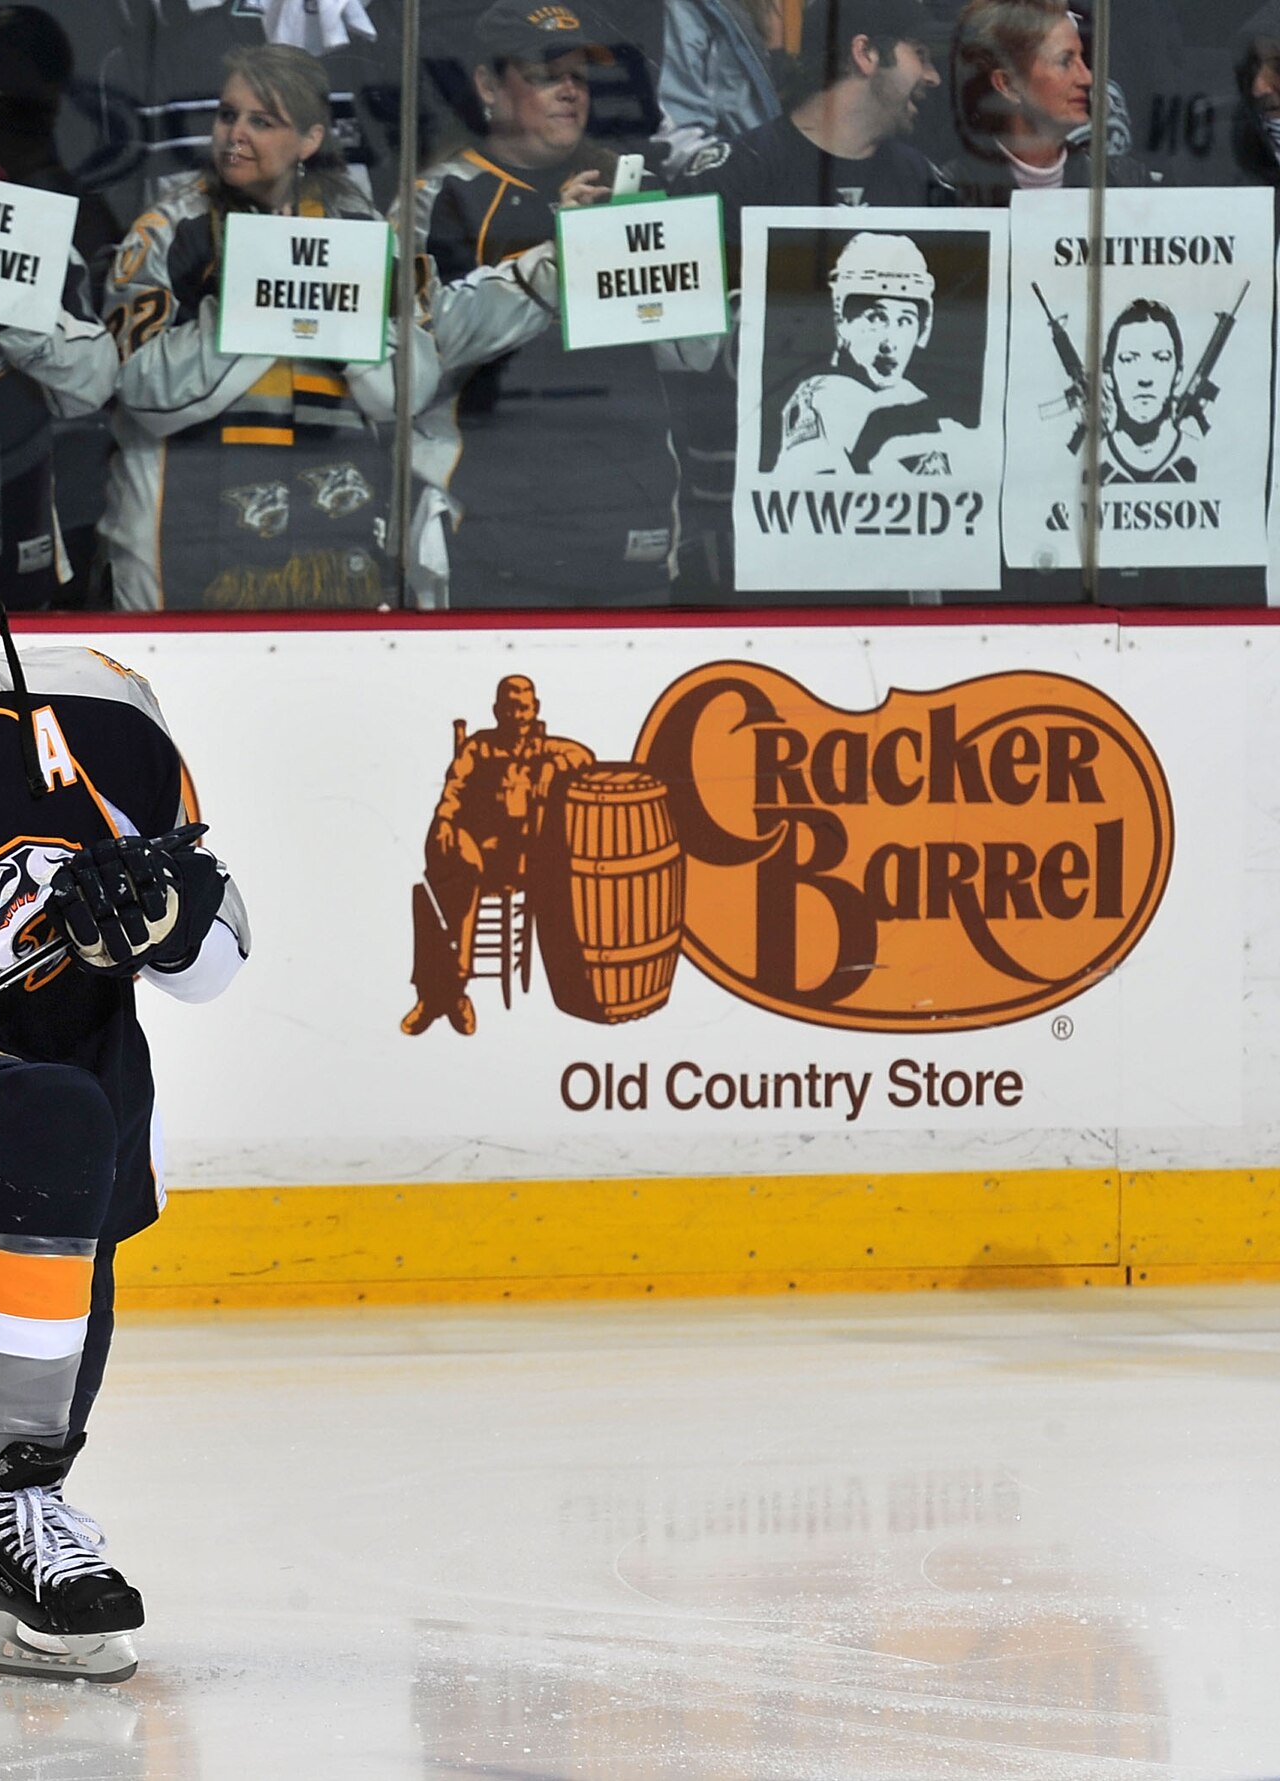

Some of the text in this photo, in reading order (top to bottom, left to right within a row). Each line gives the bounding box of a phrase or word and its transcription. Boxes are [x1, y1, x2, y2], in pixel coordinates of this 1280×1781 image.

[291, 237, 329, 267] WE
[626, 222, 666, 253] WE
[255, 279, 360, 313] BELIEVE!
[597, 261, 700, 300] BELIEVE!
[751, 490, 983, 536] WW22D?
[1045, 502, 1070, 531] &
[32, 705, 78, 793] A
[646, 676, 1106, 867] Cracker
[753, 807, 1124, 1003] Barrel
[560, 1058, 1024, 1121] Old Country Store
